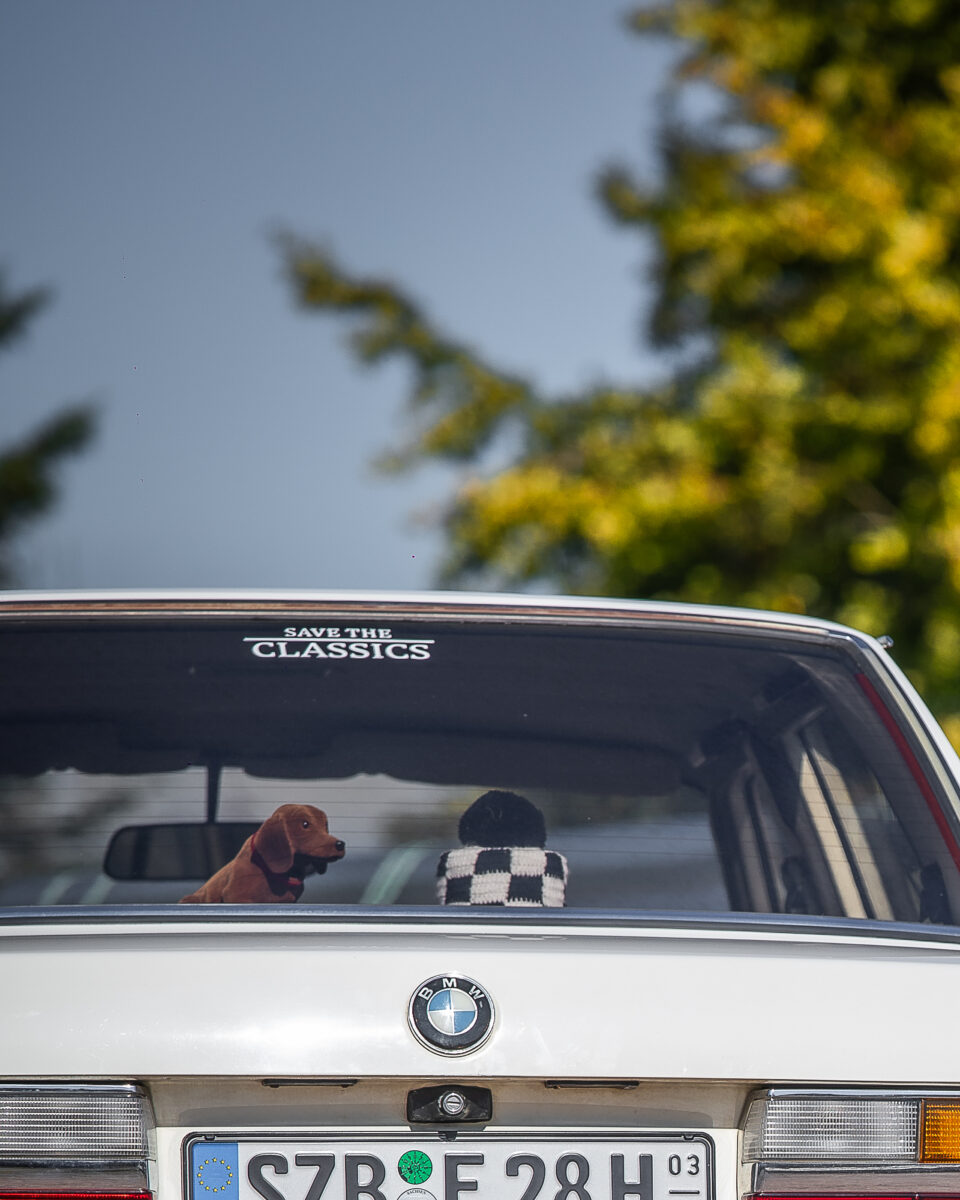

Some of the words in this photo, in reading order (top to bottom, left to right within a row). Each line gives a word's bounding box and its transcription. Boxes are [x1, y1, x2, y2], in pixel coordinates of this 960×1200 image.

[284, 628, 341, 637] SAVE
[345, 628, 393, 639] THE
[252, 642, 431, 660] CLASSICS
[418, 978, 485, 1001] BMW
[668, 1154, 700, 1176] 03
